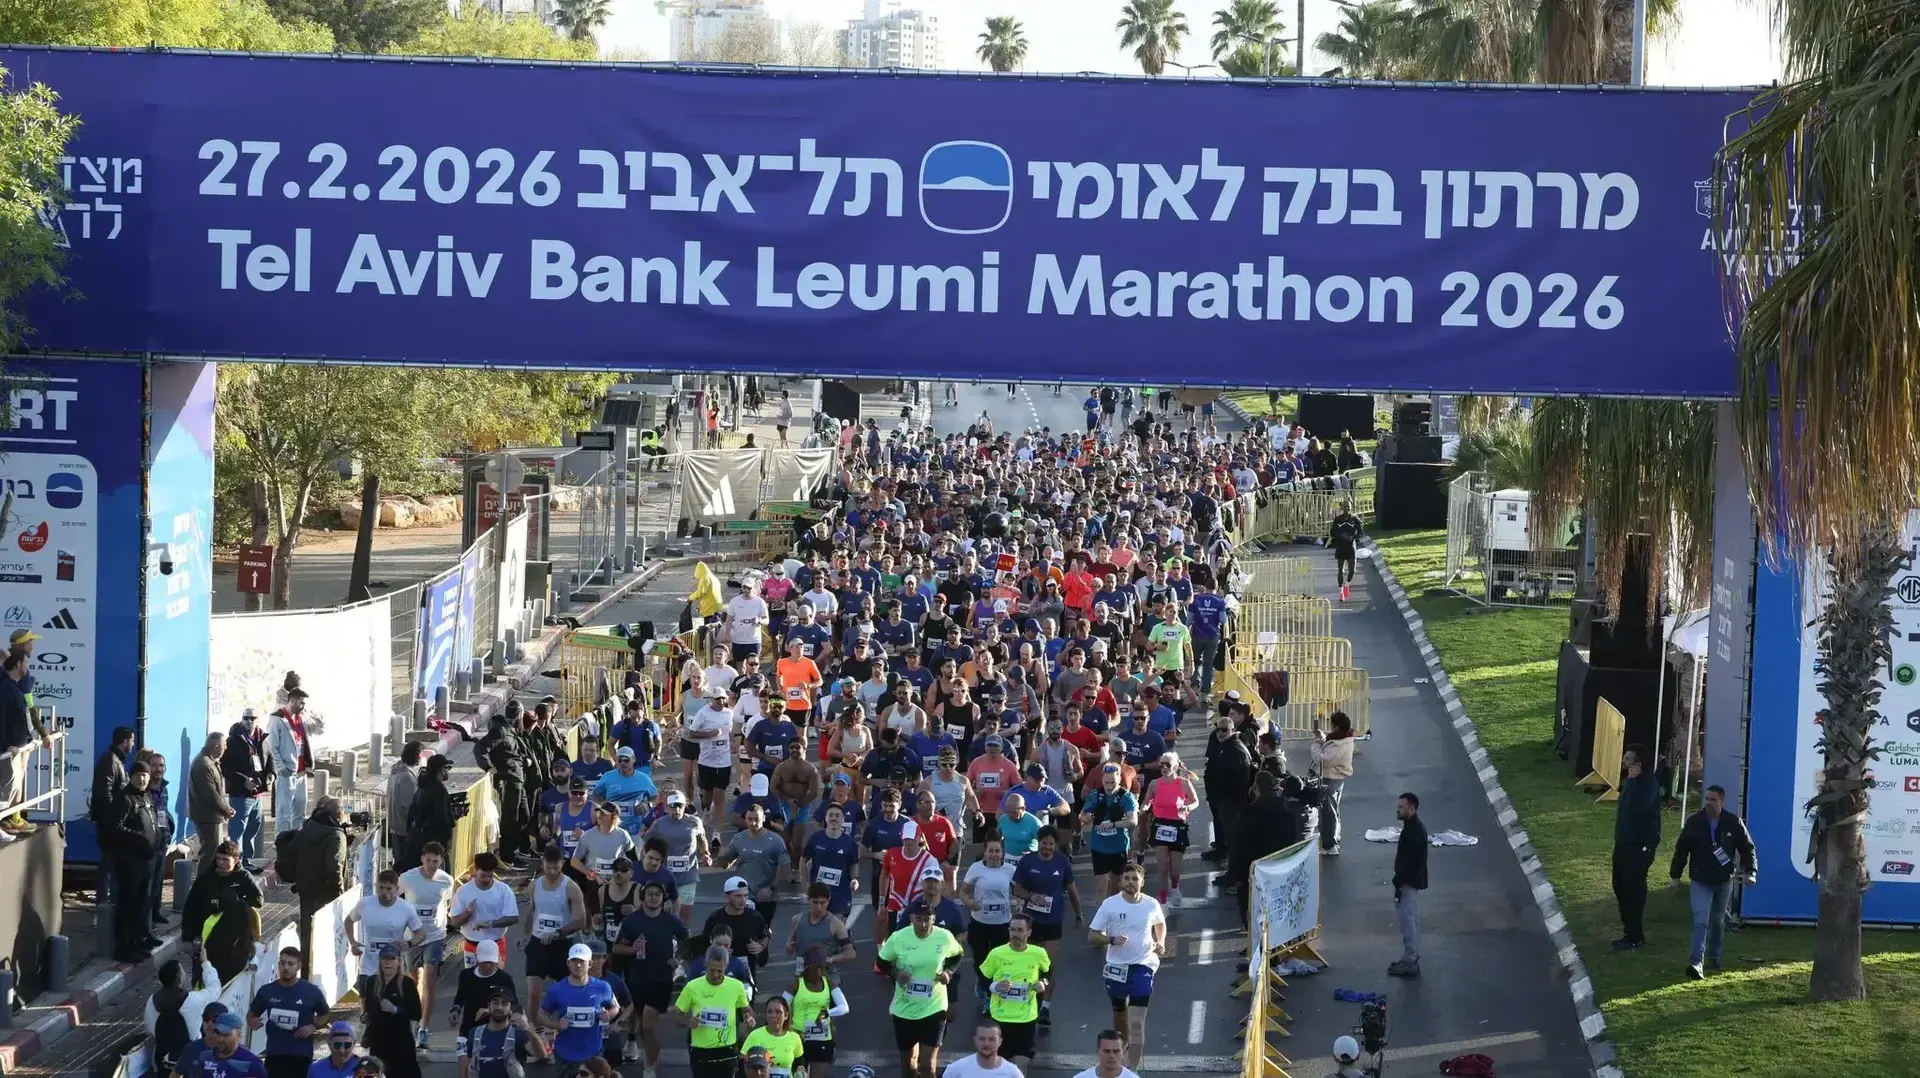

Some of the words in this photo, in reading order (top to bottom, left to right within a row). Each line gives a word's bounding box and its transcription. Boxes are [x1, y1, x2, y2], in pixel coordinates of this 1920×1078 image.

[58, 156, 142, 193] מצד
[198, 138, 562, 207] 27.2.2026
[1027, 147, 1246, 222] לאומי
[1262, 166, 1402, 235] בנק
[1420, 169, 1640, 239] מרתון
[208, 228, 311, 292] Tel
[335, 233, 503, 298] Aviv
[530, 239, 731, 307] Bank
[756, 246, 999, 313] Leumi
[1027, 252, 1413, 322] Marathon
[1440, 271, 1625, 329] 2026
[10, 388, 78, 431] RT
[0, 563, 24, 571] עזריא
[243, 560, 268, 568] PARKING
[29, 664, 76, 672] OAKLEY
[33, 683, 73, 698] arlsberg
